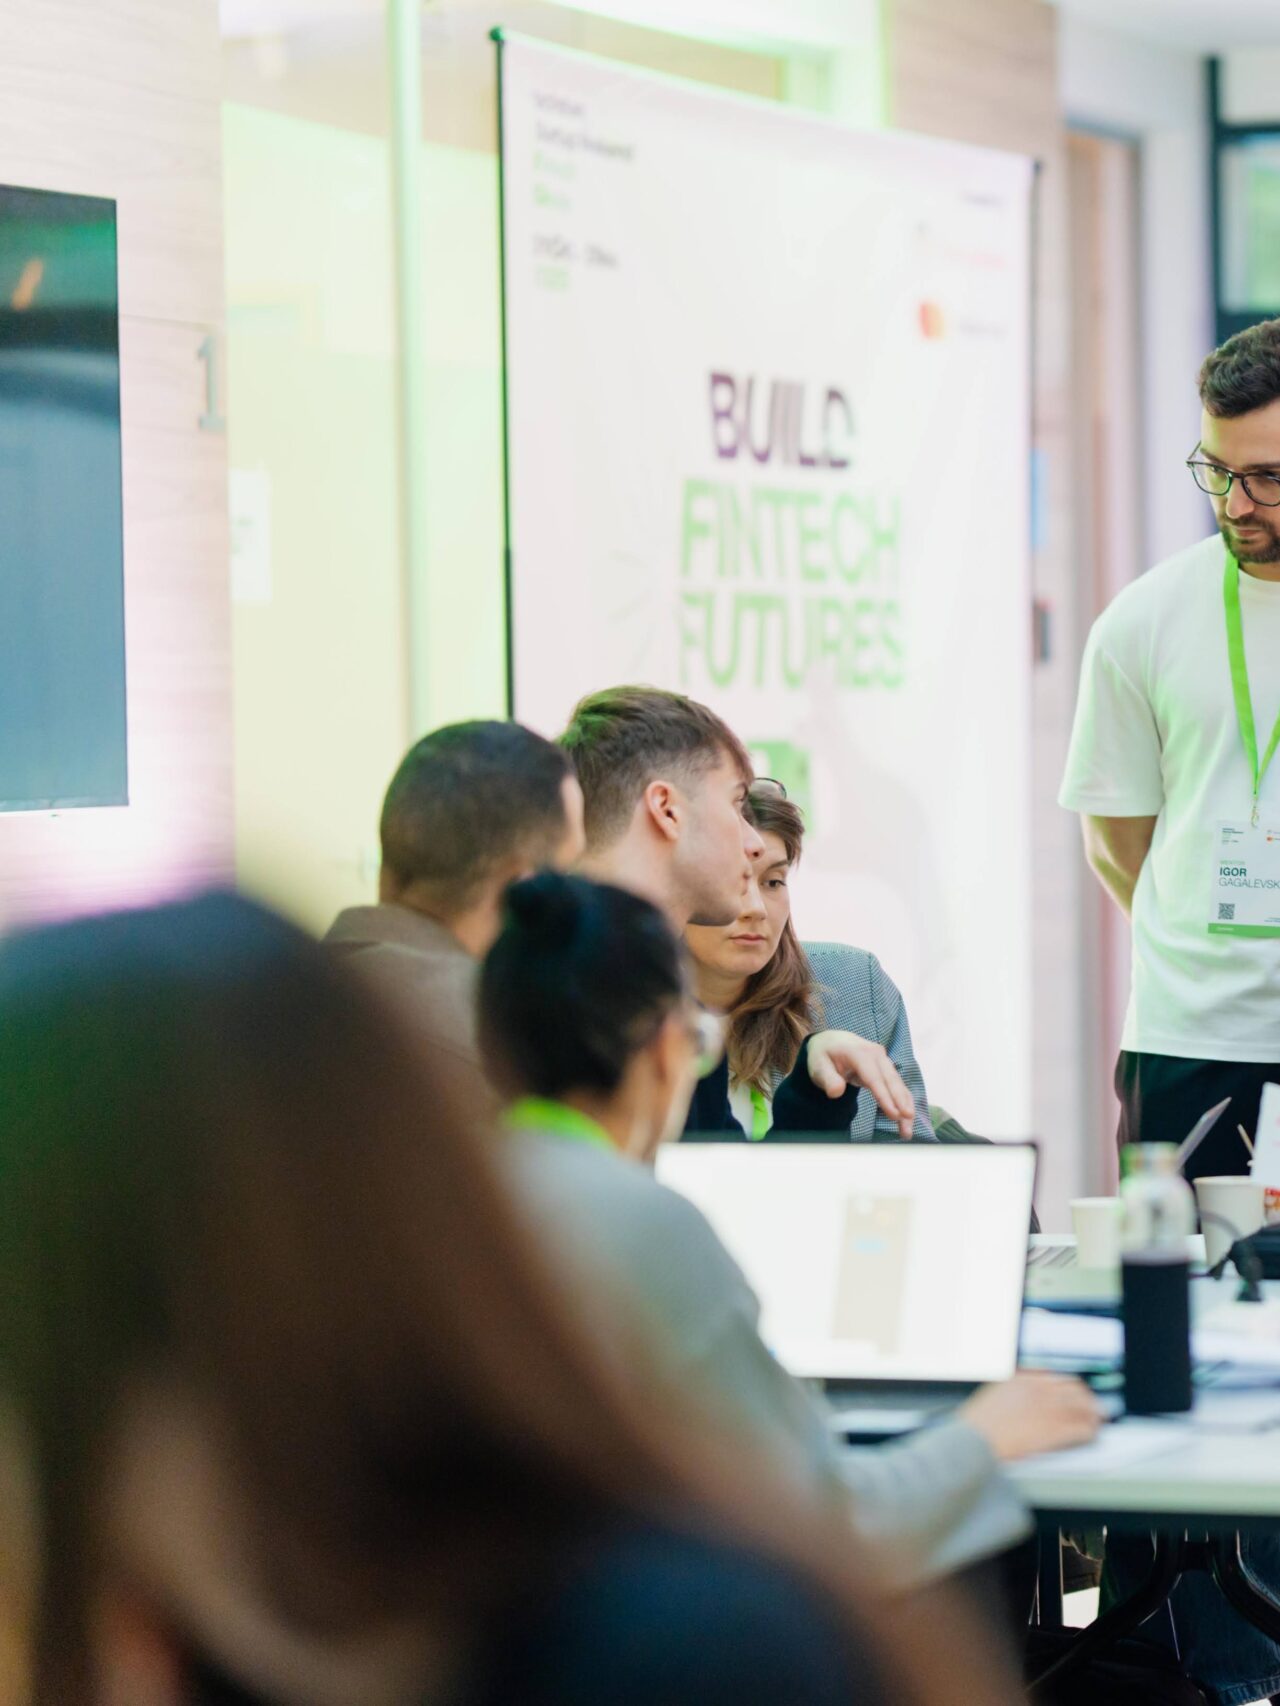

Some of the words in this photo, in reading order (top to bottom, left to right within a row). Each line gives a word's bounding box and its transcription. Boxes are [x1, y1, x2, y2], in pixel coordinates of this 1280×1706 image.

[710, 370, 855, 468] BUILD
[680, 478, 901, 583] FINTECH
[677, 590, 906, 689] FUTURES
[1219, 867, 1247, 877] IGOR
